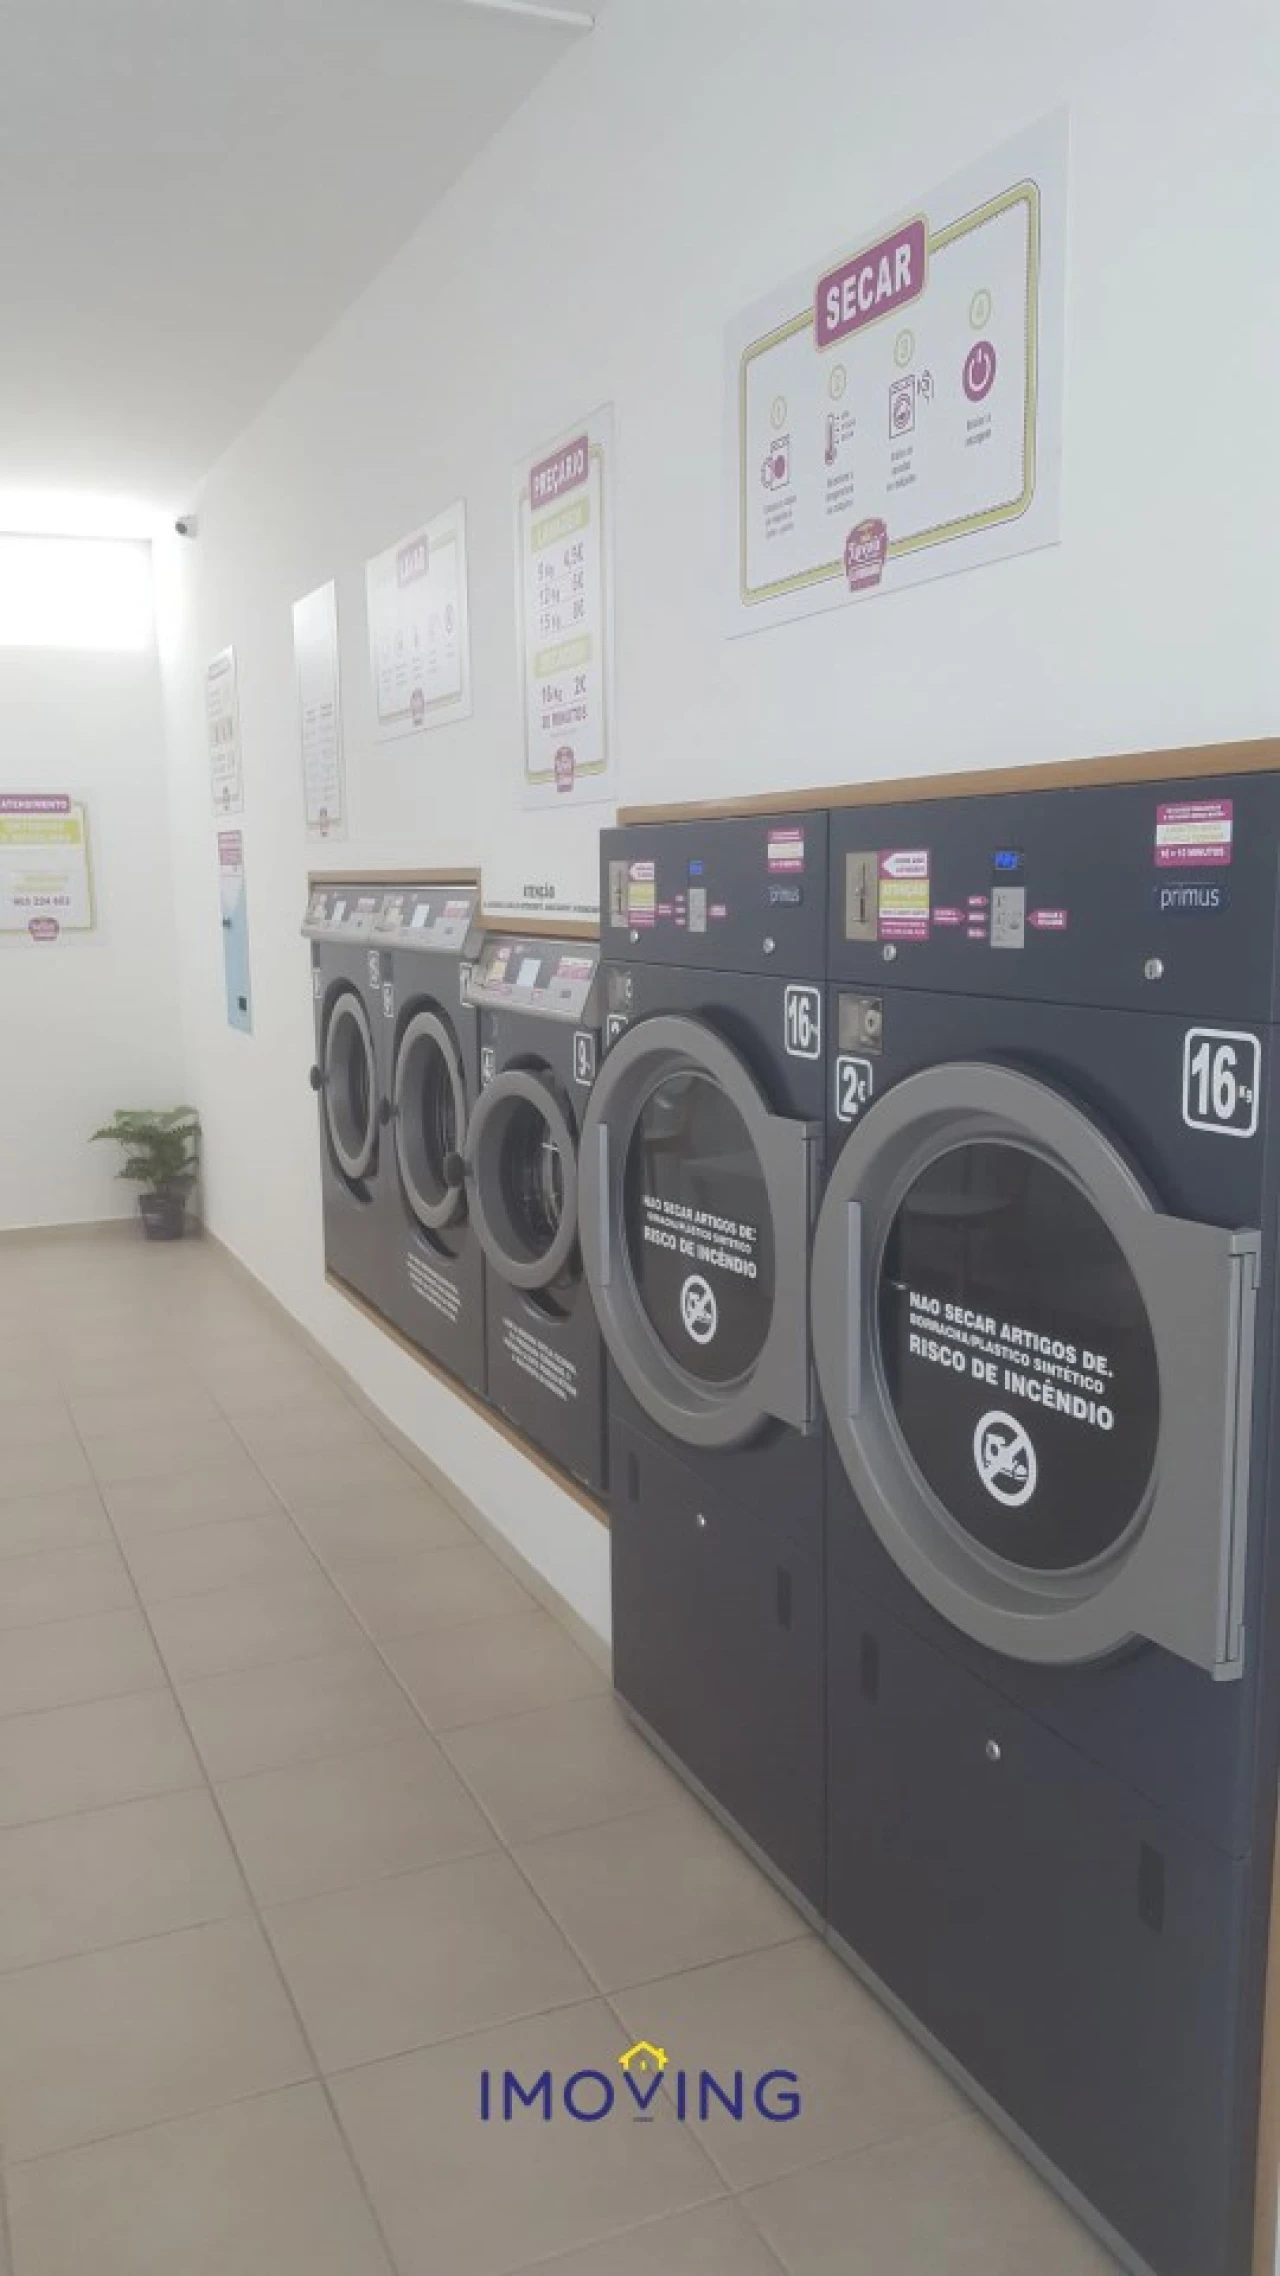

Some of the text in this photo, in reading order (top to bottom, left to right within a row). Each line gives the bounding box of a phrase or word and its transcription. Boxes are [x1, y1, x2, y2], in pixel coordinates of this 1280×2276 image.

[826, 243, 911, 330] SECAR
[1160, 884, 1219, 911] primus
[644, 1225, 677, 1250] RISCO
[679, 1237, 696, 1257] DE
[945, 1303, 997, 1336] SECAR
[1000, 1322, 1077, 1365] ARTIGOS
[909, 1334, 1115, 1431] RISCO DE INCÊNDIO
